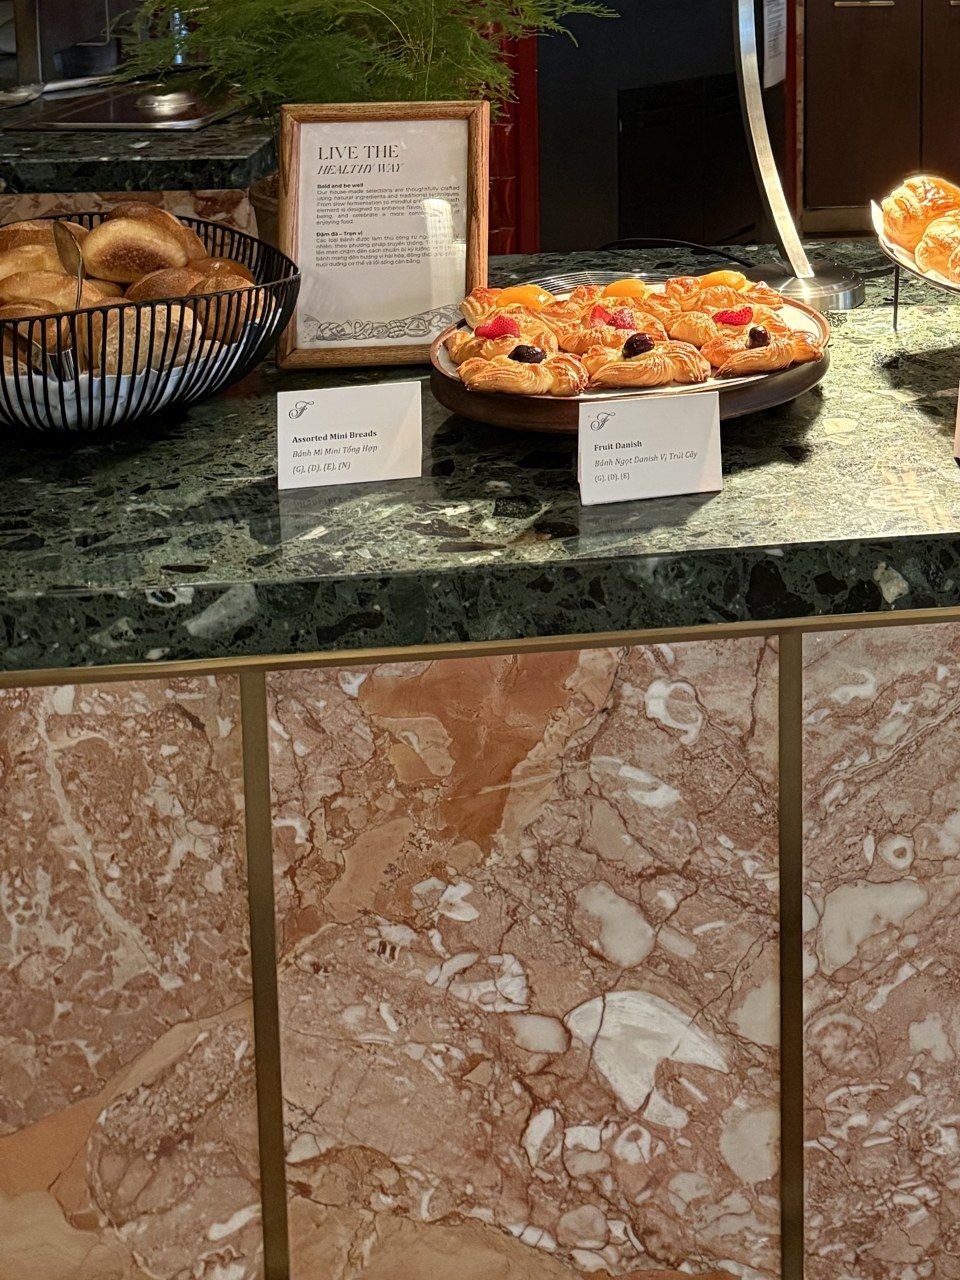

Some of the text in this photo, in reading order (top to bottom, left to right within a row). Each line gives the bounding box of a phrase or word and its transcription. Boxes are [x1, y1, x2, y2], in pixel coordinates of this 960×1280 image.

[319, 145, 398, 159] LIVE THE
[318, 164, 403, 174] HEALTHY WAY
[292, 434, 327, 443] Assorted
[350, 430, 377, 438] Breads
[616, 441, 642, 449] Danish
[293, 449, 311, 458] Bánh
[595, 459, 613, 467] Bánh
[615, 458, 632, 466] Ngọt
[634, 454, 658, 463] Danish
[661, 454, 667, 462] Vị
[338, 462, 350, 470] (N)
